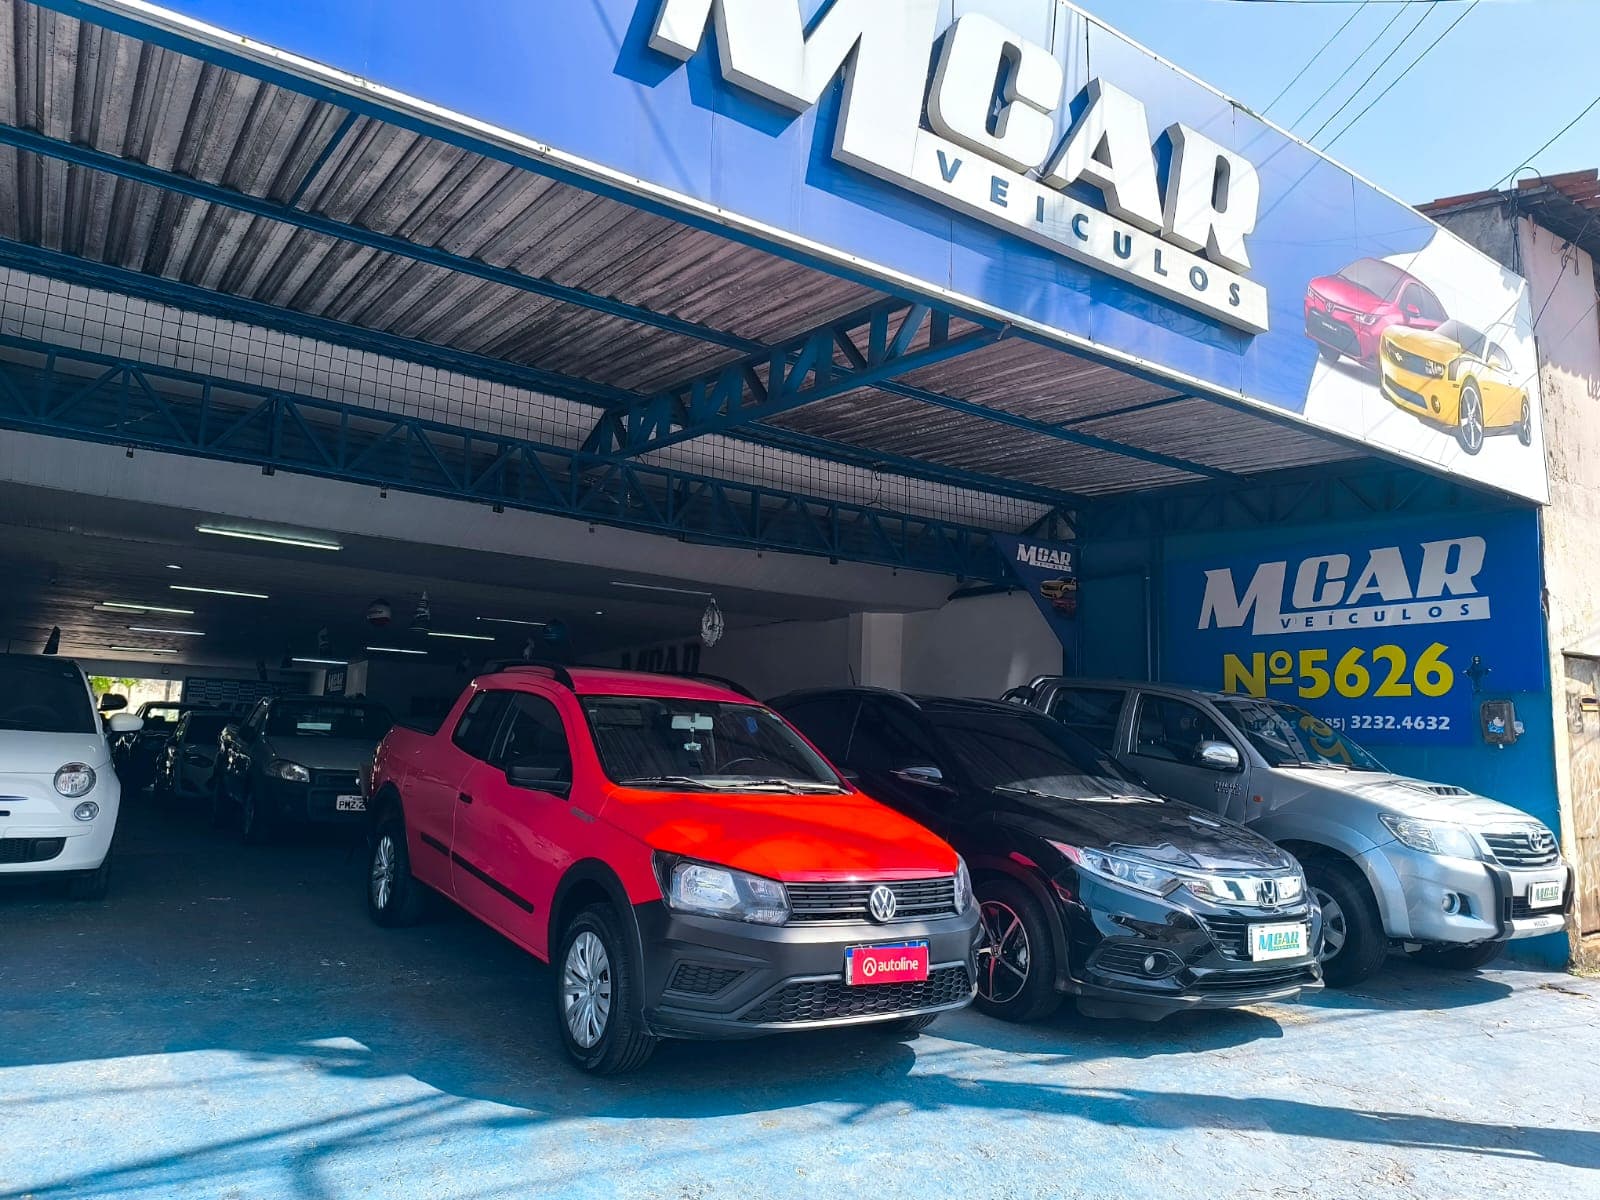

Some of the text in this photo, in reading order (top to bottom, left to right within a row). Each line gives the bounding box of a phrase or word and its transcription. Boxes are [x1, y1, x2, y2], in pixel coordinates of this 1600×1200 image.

[1016, 543, 1072, 567] MCAR
[1198, 536, 1486, 635] MCAR
[1280, 602, 1470, 629] VEÍCULOS
[1350, 715, 1451, 731] 3232.4632
[1258, 931, 1300, 952] MCAR
[877, 956, 919, 972] autoline
